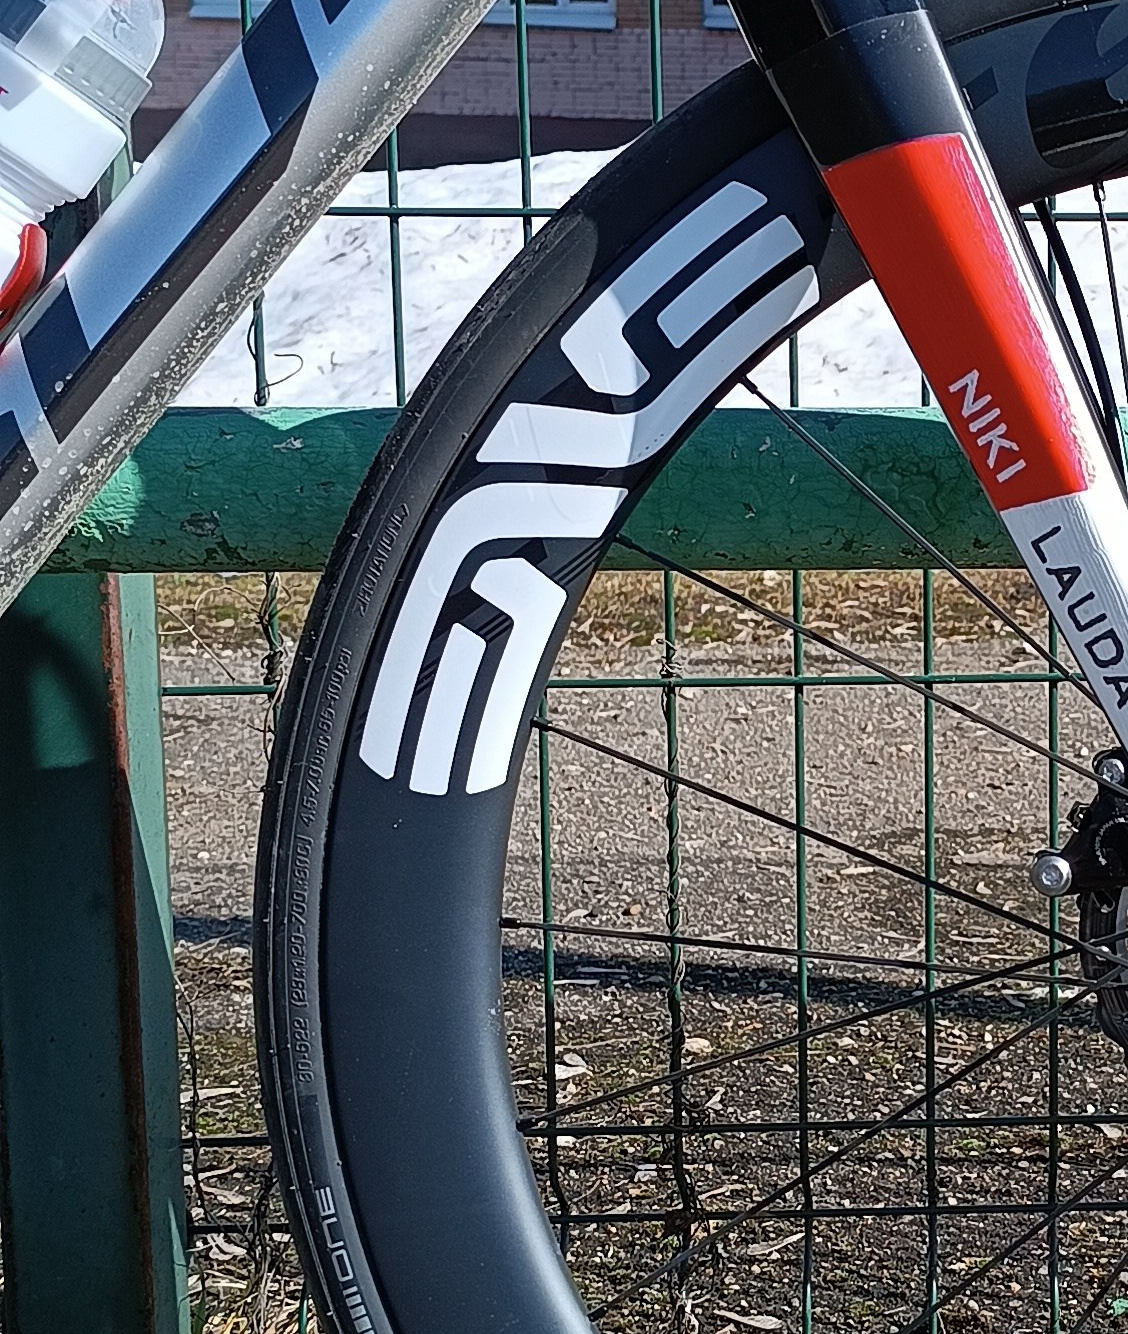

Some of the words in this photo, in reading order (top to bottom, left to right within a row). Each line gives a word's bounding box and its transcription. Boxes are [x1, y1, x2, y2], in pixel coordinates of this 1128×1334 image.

[948, 369, 1026, 483] NIKI
[358, 180, 821, 796] ENVE
[316, 1186, 353, 1281] ONE
